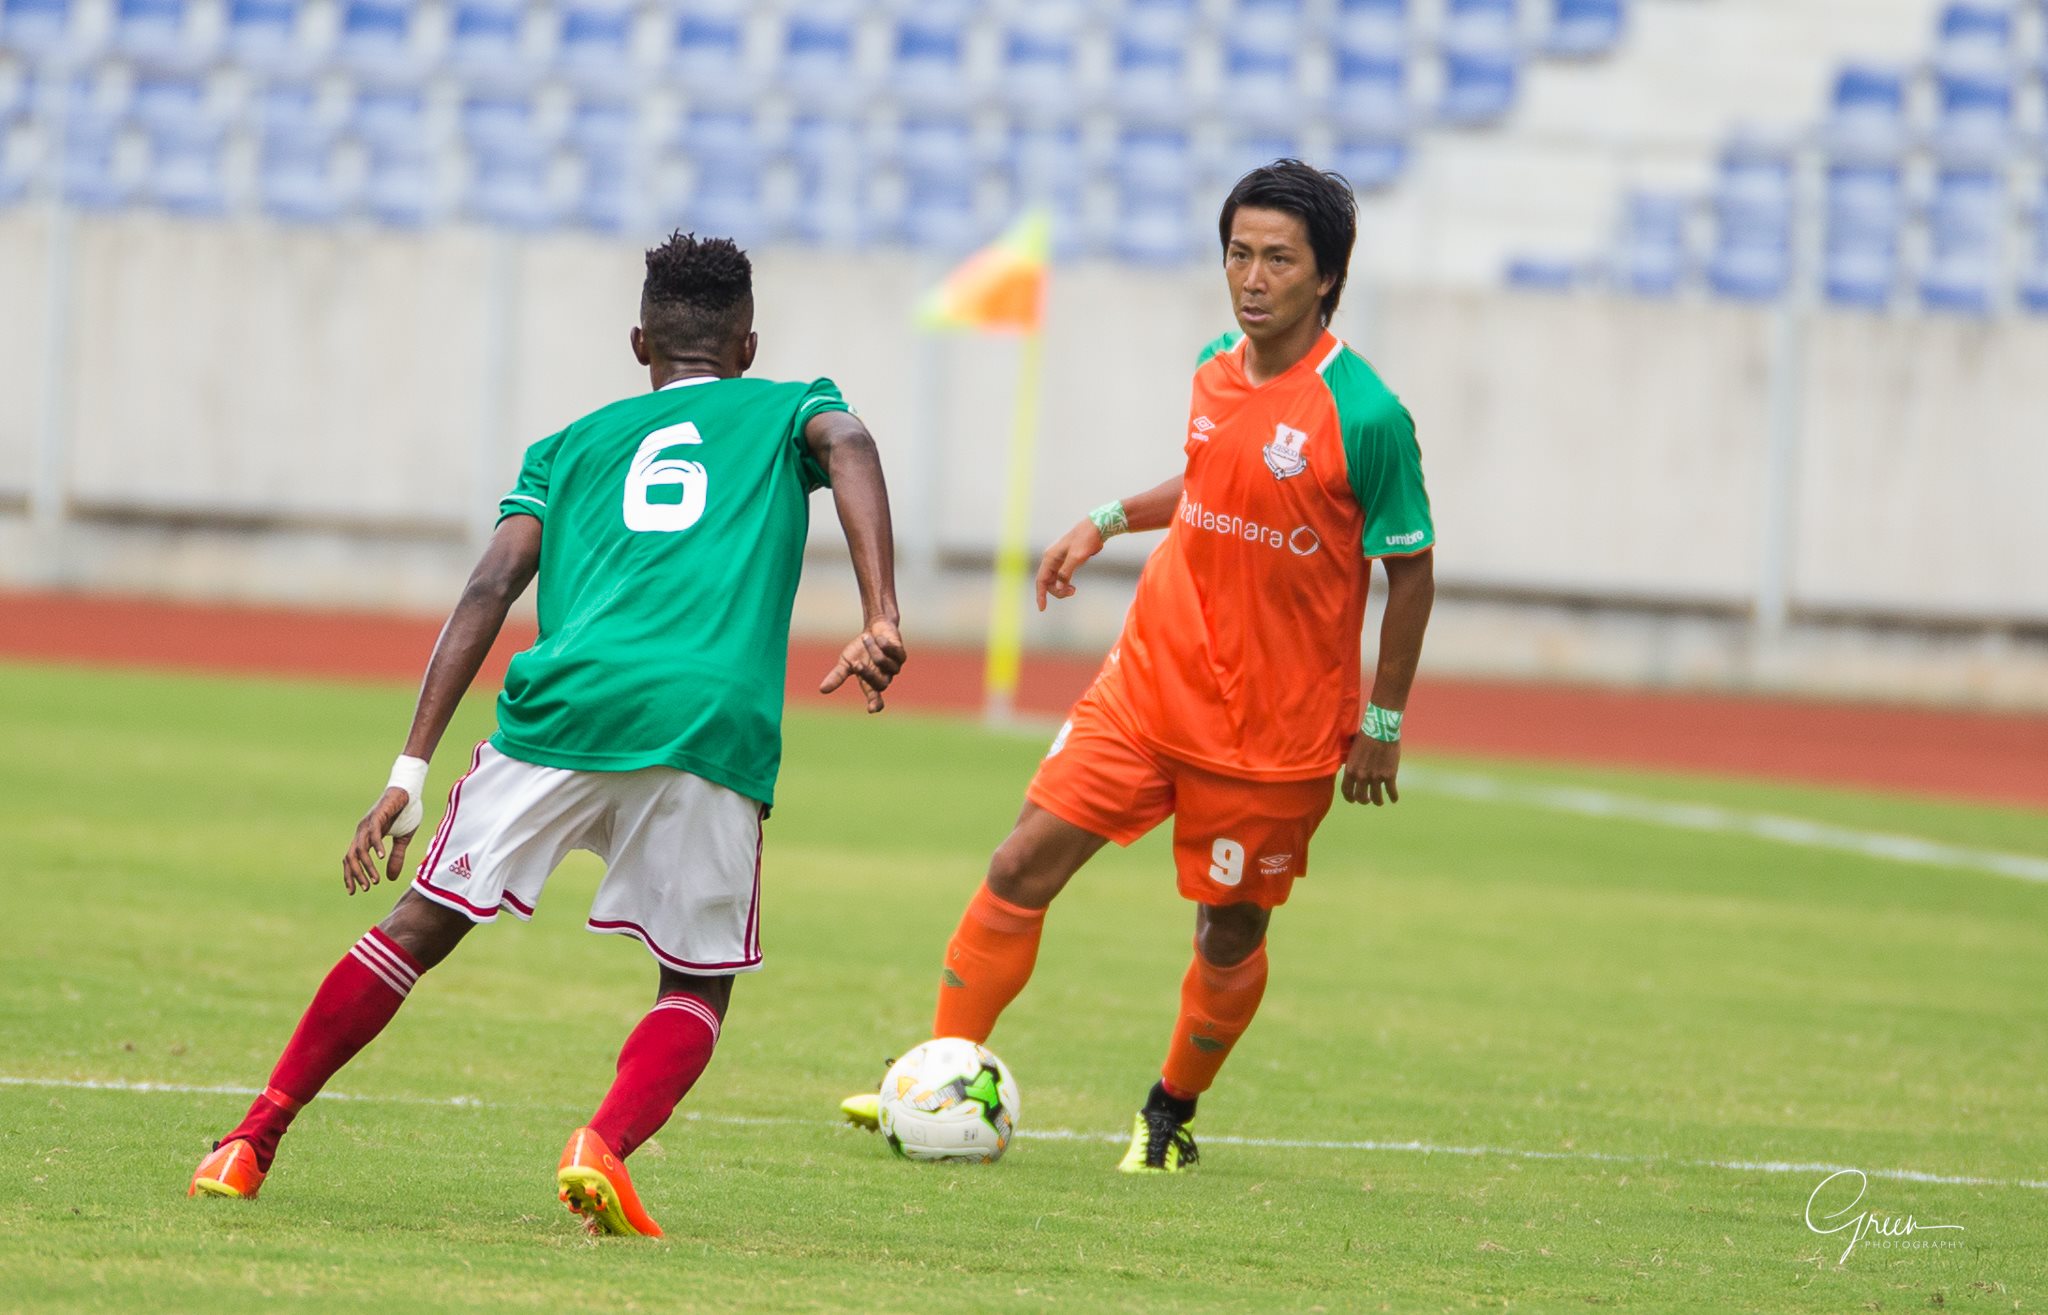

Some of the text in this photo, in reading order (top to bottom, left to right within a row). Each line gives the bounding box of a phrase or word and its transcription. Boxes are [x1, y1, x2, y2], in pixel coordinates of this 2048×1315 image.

[623, 421, 708, 532] 6
[1385, 530, 1424, 545] umbro
[1209, 838, 1245, 886] 9
